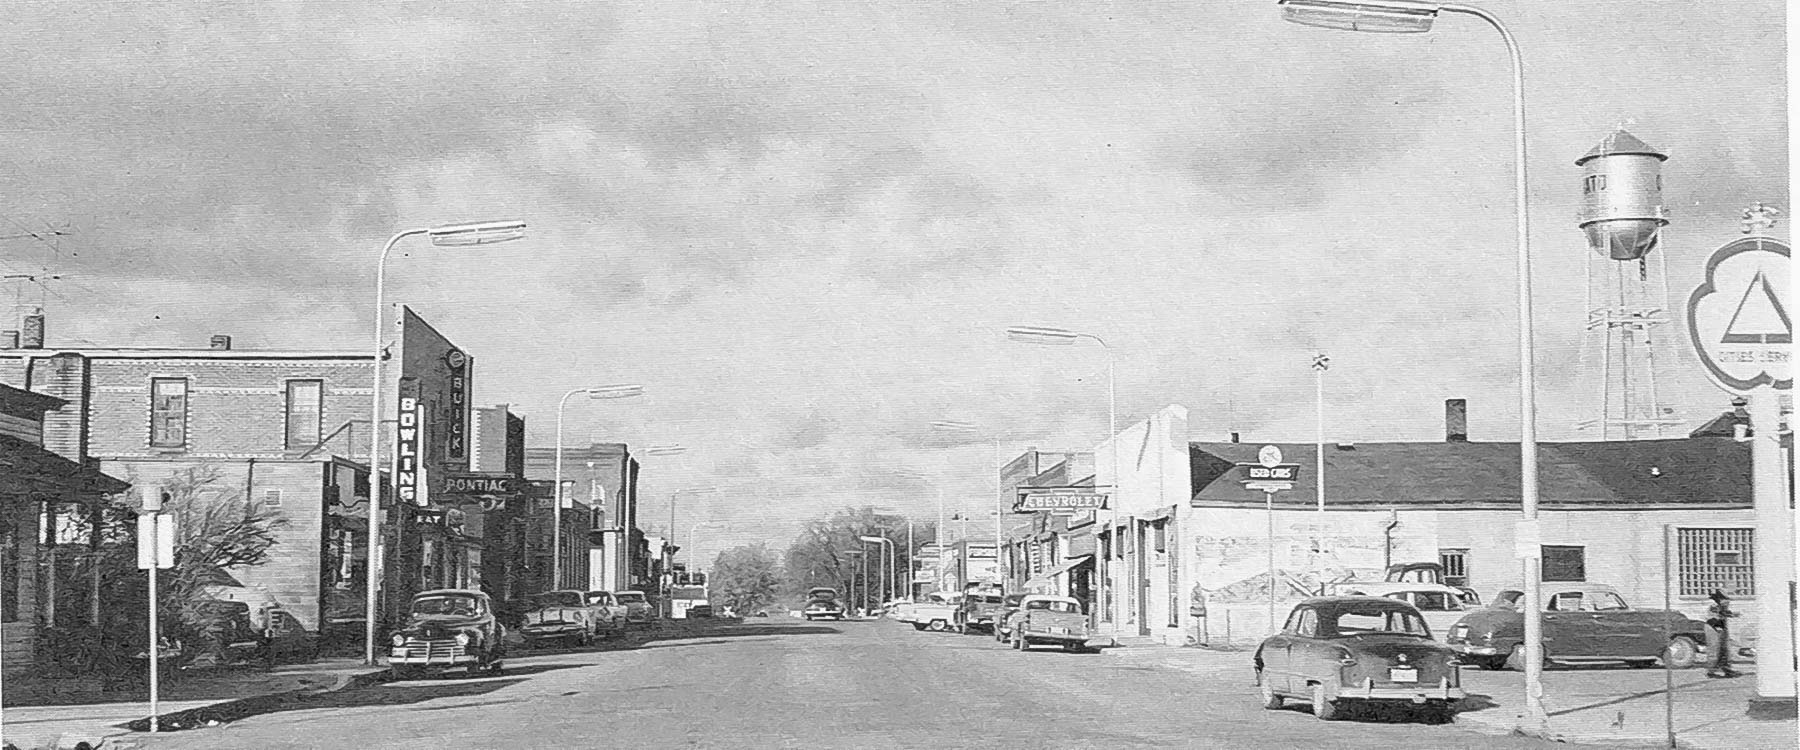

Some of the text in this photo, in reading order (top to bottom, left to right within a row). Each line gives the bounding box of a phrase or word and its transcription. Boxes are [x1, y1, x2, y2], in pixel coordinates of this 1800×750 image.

[1759, 350, 1792, 362] SERV
[452, 377, 463, 449] BUICK
[400, 397, 416, 503] BOWLING
[1250, 467, 1291, 479] USED CARS
[443, 479, 506, 493] PONTIAC
[1028, 496, 1101, 507] CHEVROLET
[416, 515, 441, 525] EAT
